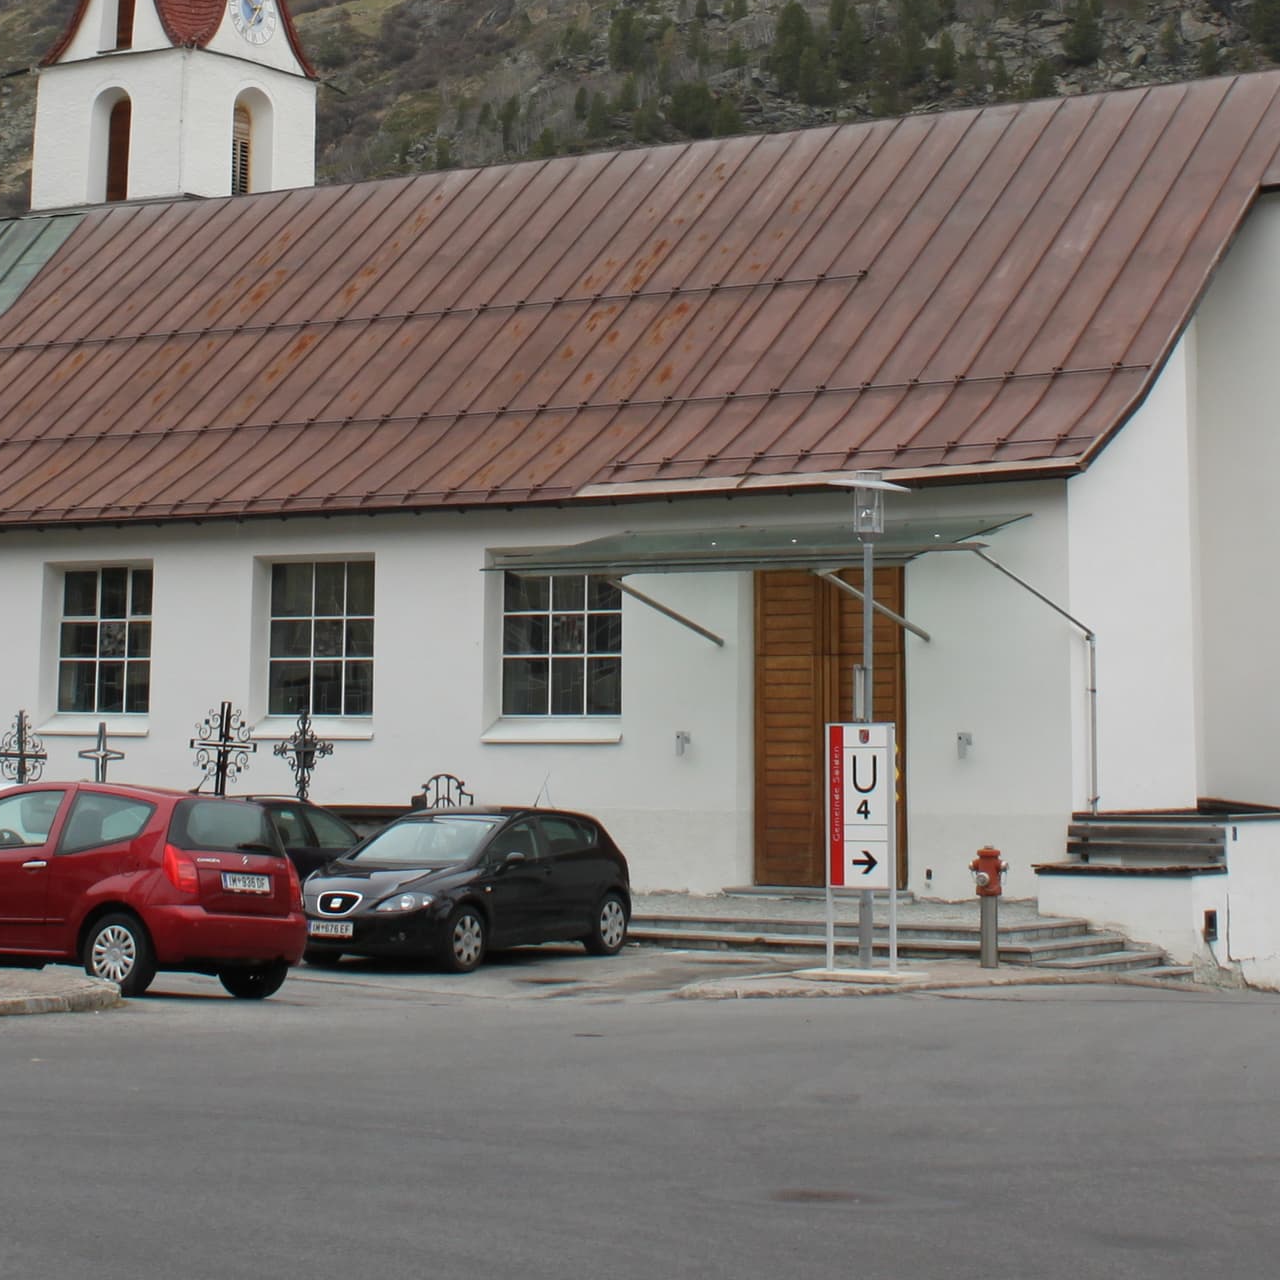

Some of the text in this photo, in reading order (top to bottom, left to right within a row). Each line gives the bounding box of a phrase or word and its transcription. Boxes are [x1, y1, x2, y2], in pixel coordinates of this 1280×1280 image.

[852, 755, 877, 794] U
[832, 787, 841, 842] Gemeinde
[856, 799, 870, 820] 4
